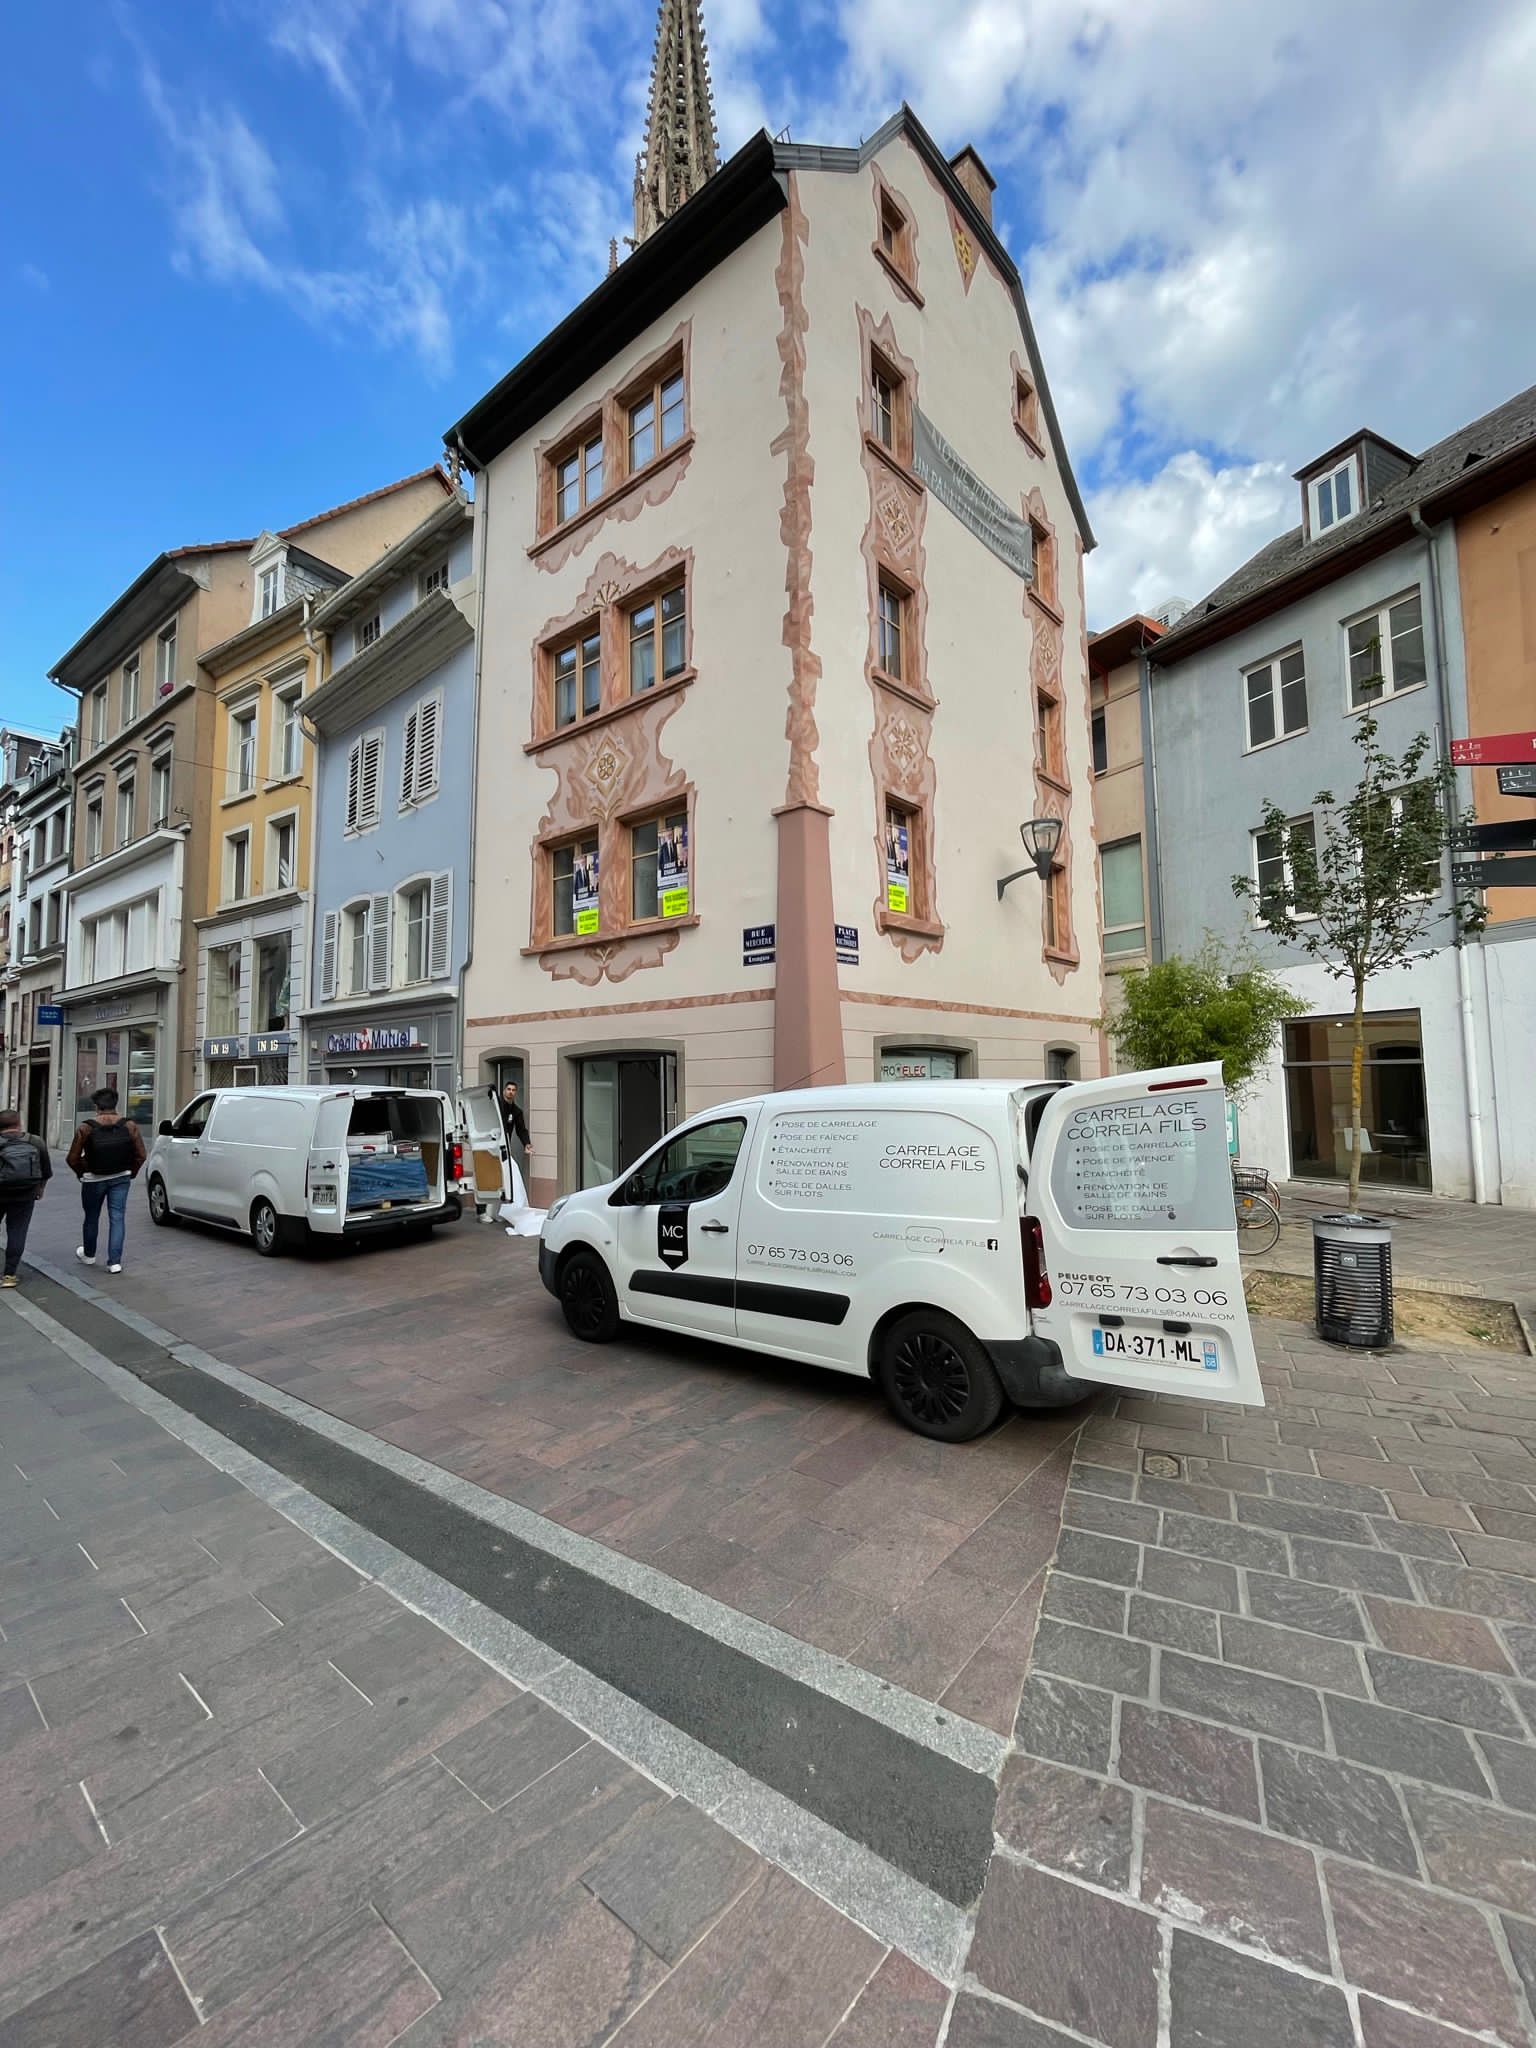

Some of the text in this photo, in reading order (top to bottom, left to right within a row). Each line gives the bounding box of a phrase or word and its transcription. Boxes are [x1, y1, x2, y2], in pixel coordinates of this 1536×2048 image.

[751, 929, 766, 938] RUE
[838, 927, 856, 938] PLACE
[371, 1025, 411, 1050] Mutuel
[221, 1043, 230, 1055] 19
[902, 1065, 927, 1076] ELEC
[1074, 1101, 1199, 1124] CARRELAGE
[821, 1120, 879, 1128] CARRELAGE
[1067, 1118, 1207, 1140] CORREIA FILS
[885, 1145, 981, 1157] CARRELAGE
[1112, 1143, 1126, 1152] DE
[1128, 1140, 1196, 1151] CARRELAGE
[879, 1158, 985, 1172] CORREIA FILS
[1082, 1158, 1110, 1166] POSE
[1112, 1157, 1125, 1165] DE
[776, 1168, 802, 1176] SALLE
[820, 1169, 848, 1177] BAINS
[775, 1180, 799, 1189] POSE
[816, 1183, 853, 1191] DALLES
[1153, 1182, 1169, 1190] DE
[774, 1189, 823, 1198] SUR PLOTS
[1117, 1191, 1130, 1199] DE
[1084, 1204, 1175, 1212] POSE DE DALLES
[1085, 1212, 1142, 1221] SUR PLOTS
[662, 1224, 684, 1239] MC
[747, 1244, 854, 1267] 07 65 73 03 06
[1057, 1272, 1112, 1283] PEUGEOT
[1059, 1281, 1228, 1306] 07 65 73 03 06
[1104, 1331, 1201, 1363] DA-371-ML
